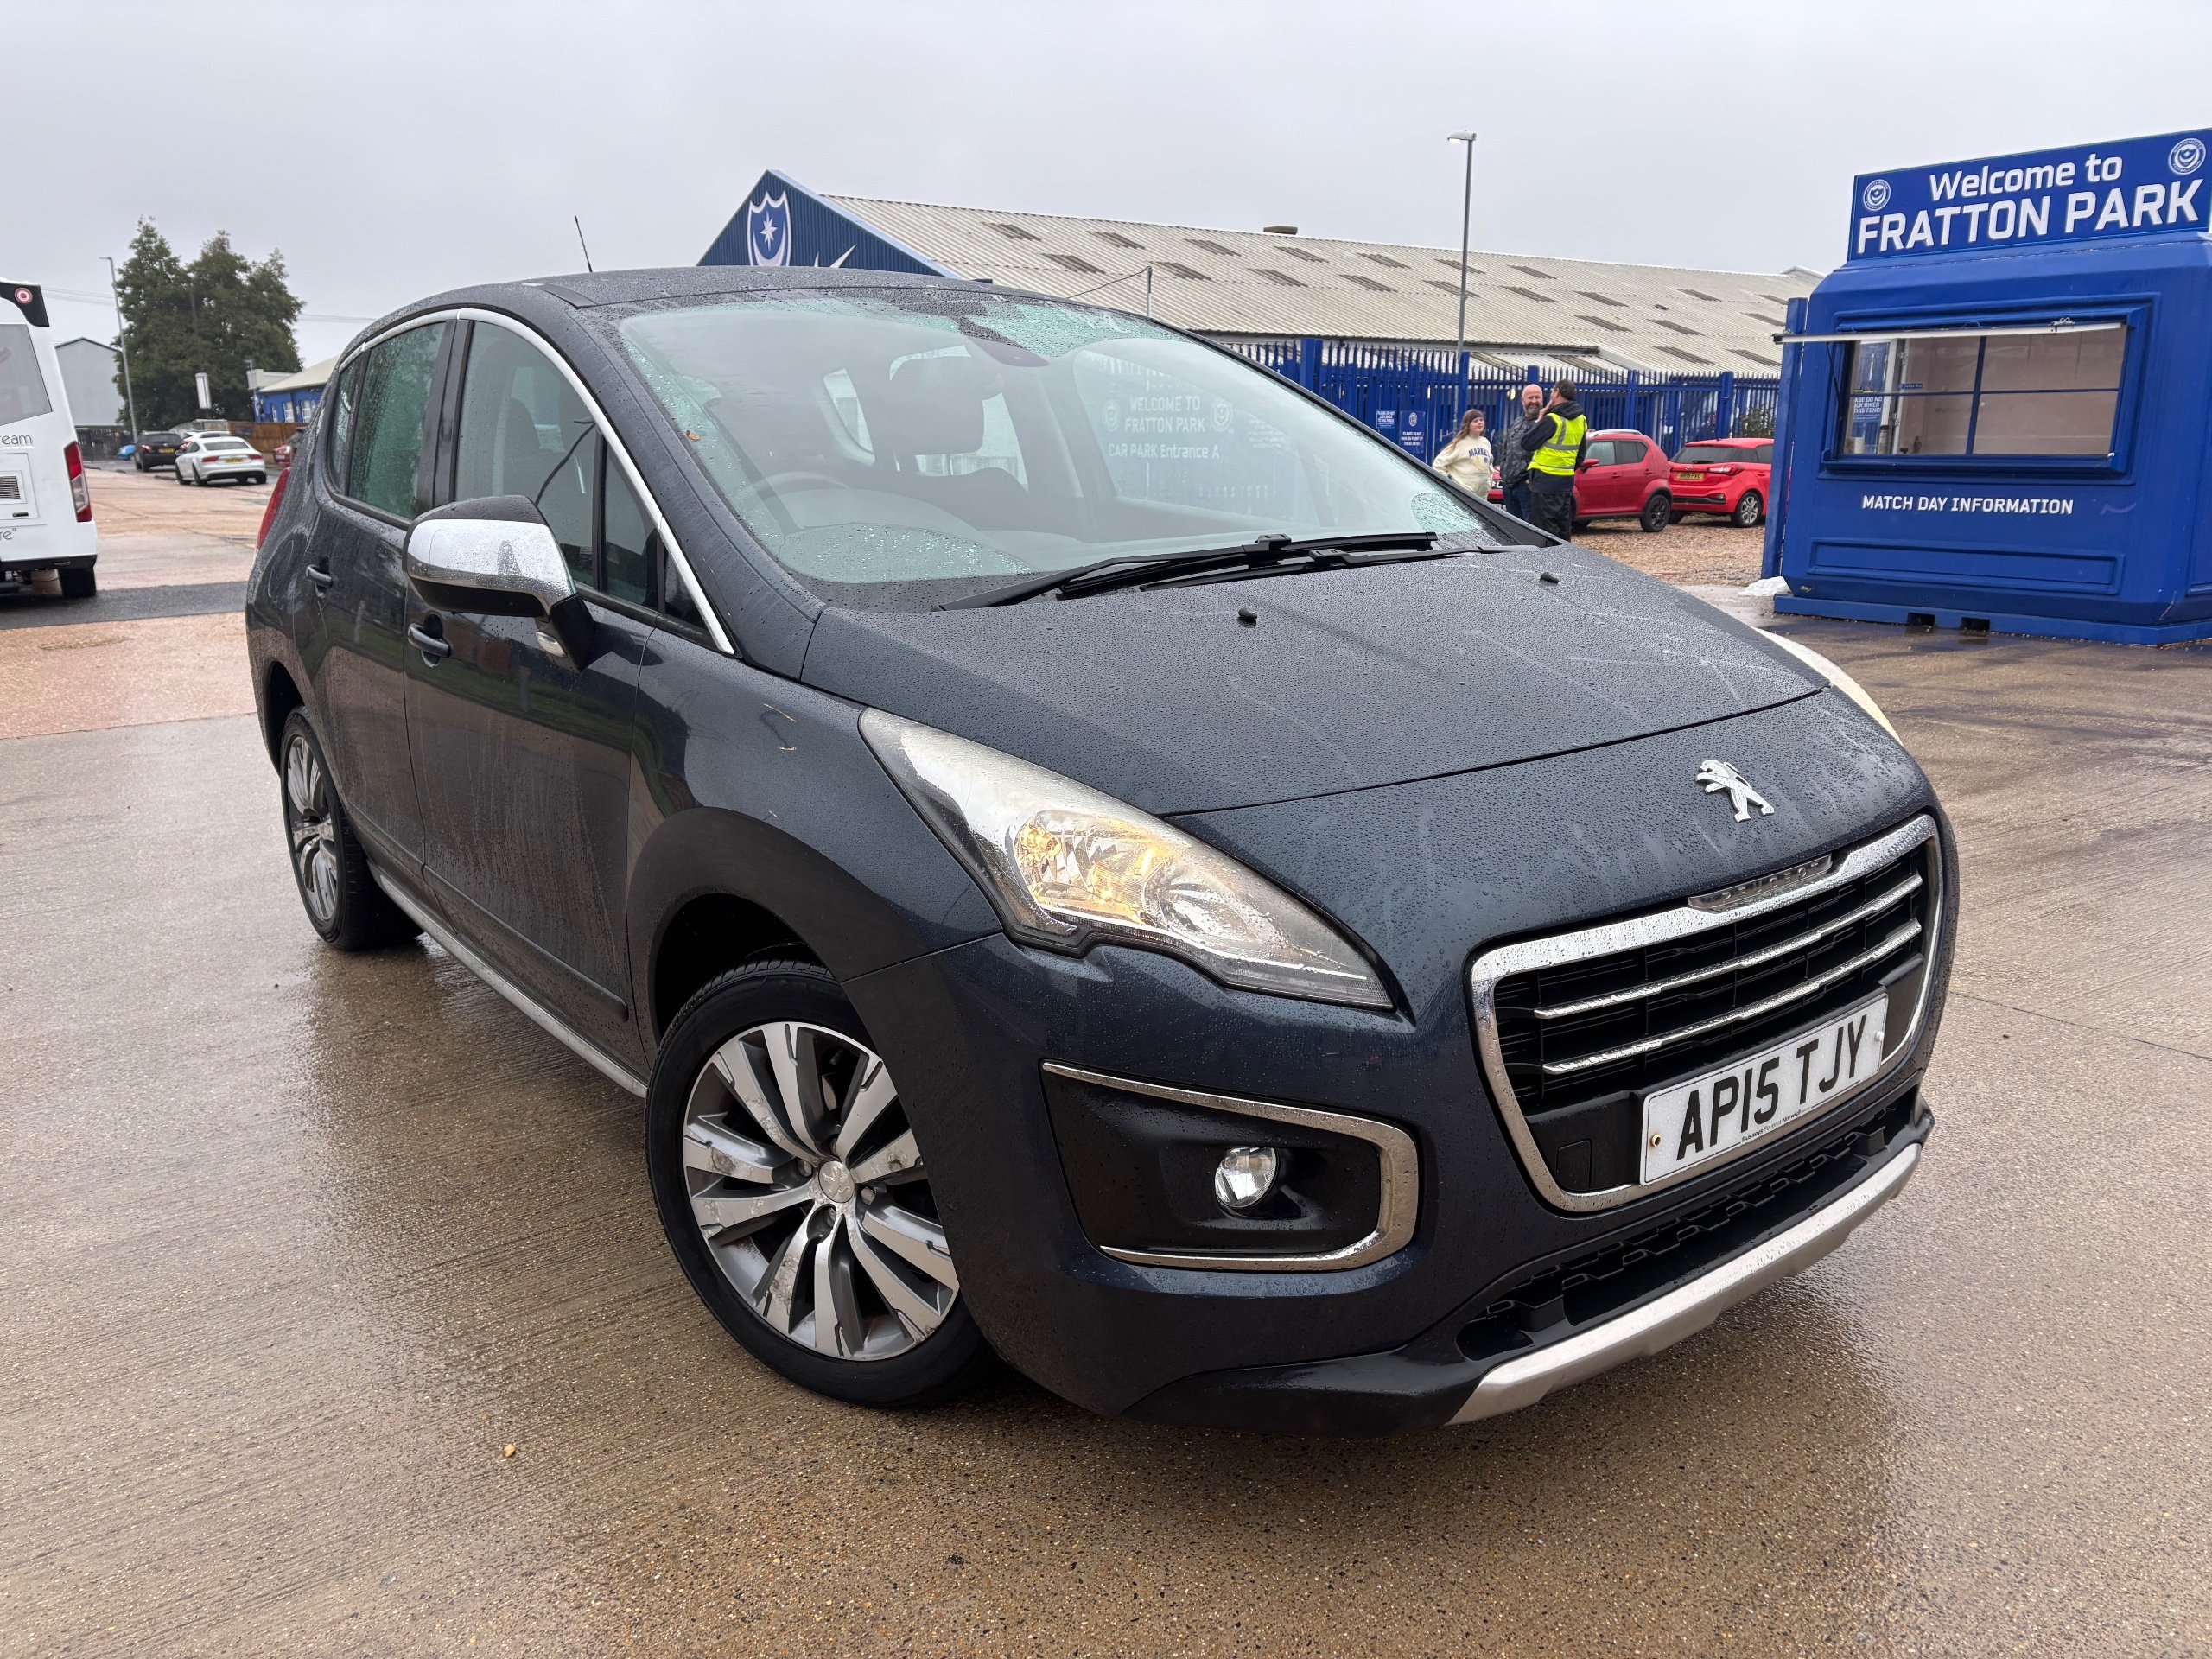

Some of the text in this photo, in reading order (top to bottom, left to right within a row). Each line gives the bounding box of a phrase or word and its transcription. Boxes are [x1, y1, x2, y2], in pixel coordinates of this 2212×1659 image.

[1929, 153, 2123, 201] Welcome to
[1856, 178, 2204, 254] FRATTON PARK
[1130, 395, 1201, 412] WELCOME TO
[1125, 417, 1205, 433] FRATTON PARK
[1108, 443, 1220, 459] CAR PARK Entrance A
[1861, 495, 2074, 514] MATCH DAY INFORMATION
[1675, 1014, 1867, 1161] AP15 TJY
[1741, 1128, 1764, 1143] Busseys
[1782, 1109, 1802, 1123] Norwich
